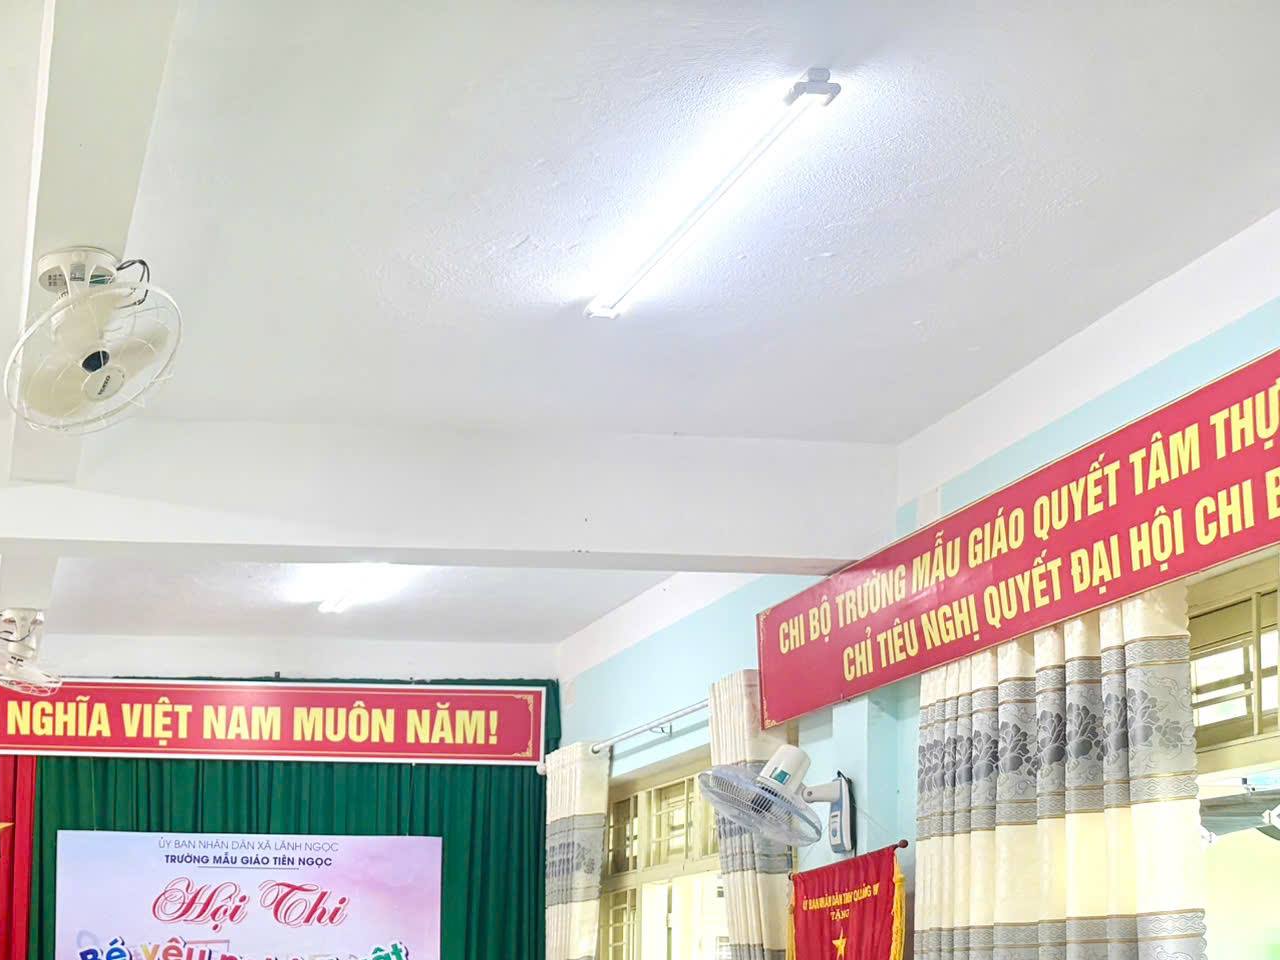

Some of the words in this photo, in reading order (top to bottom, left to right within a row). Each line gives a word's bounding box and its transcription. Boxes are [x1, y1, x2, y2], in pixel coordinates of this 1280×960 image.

[779, 614, 805, 654] CHI
[809, 595, 832, 642] BỘ
[836, 569, 906, 628] TRƯỜNG
[911, 530, 961, 594] MẪU
[968, 507, 1025, 569] GIÁO
[1033, 452, 1120, 541] QUYẾT
[1129, 431, 1200, 496] TÂM
[842, 627, 874, 681] CHỈ
[877, 617, 919, 668] TIÊU
[921, 593, 980, 650] NGHỊ
[983, 549, 1062, 629] QUYẾT
[1070, 534, 1121, 595] ĐẠI
[1129, 505, 1185, 572] HỘI
[1195, 479, 1255, 546] CHI
[7, 695, 112, 738] NGHĨA
[120, 696, 193, 746] VIỆT
[202, 704, 281, 742] NAM
[293, 700, 395, 744] MUÔN
[406, 703, 499, 746] NĂM!
[165, 854, 209, 864] TRƯỜNG
[213, 852, 237, 865] MẪU
[241, 854, 270, 866] GIÁO
[273, 854, 295, 866] TIÊN
[298, 857, 332, 869] NGỌC
[174, 839, 196, 849] BAN
[198, 839, 229, 850] NHÂN
[231, 839, 255, 850] DÂN
[257, 839, 272, 851] XÃ
[304, 842, 340, 853] NGỌC
[152, 876, 248, 932] Hội
[258, 880, 349, 927] Thi
